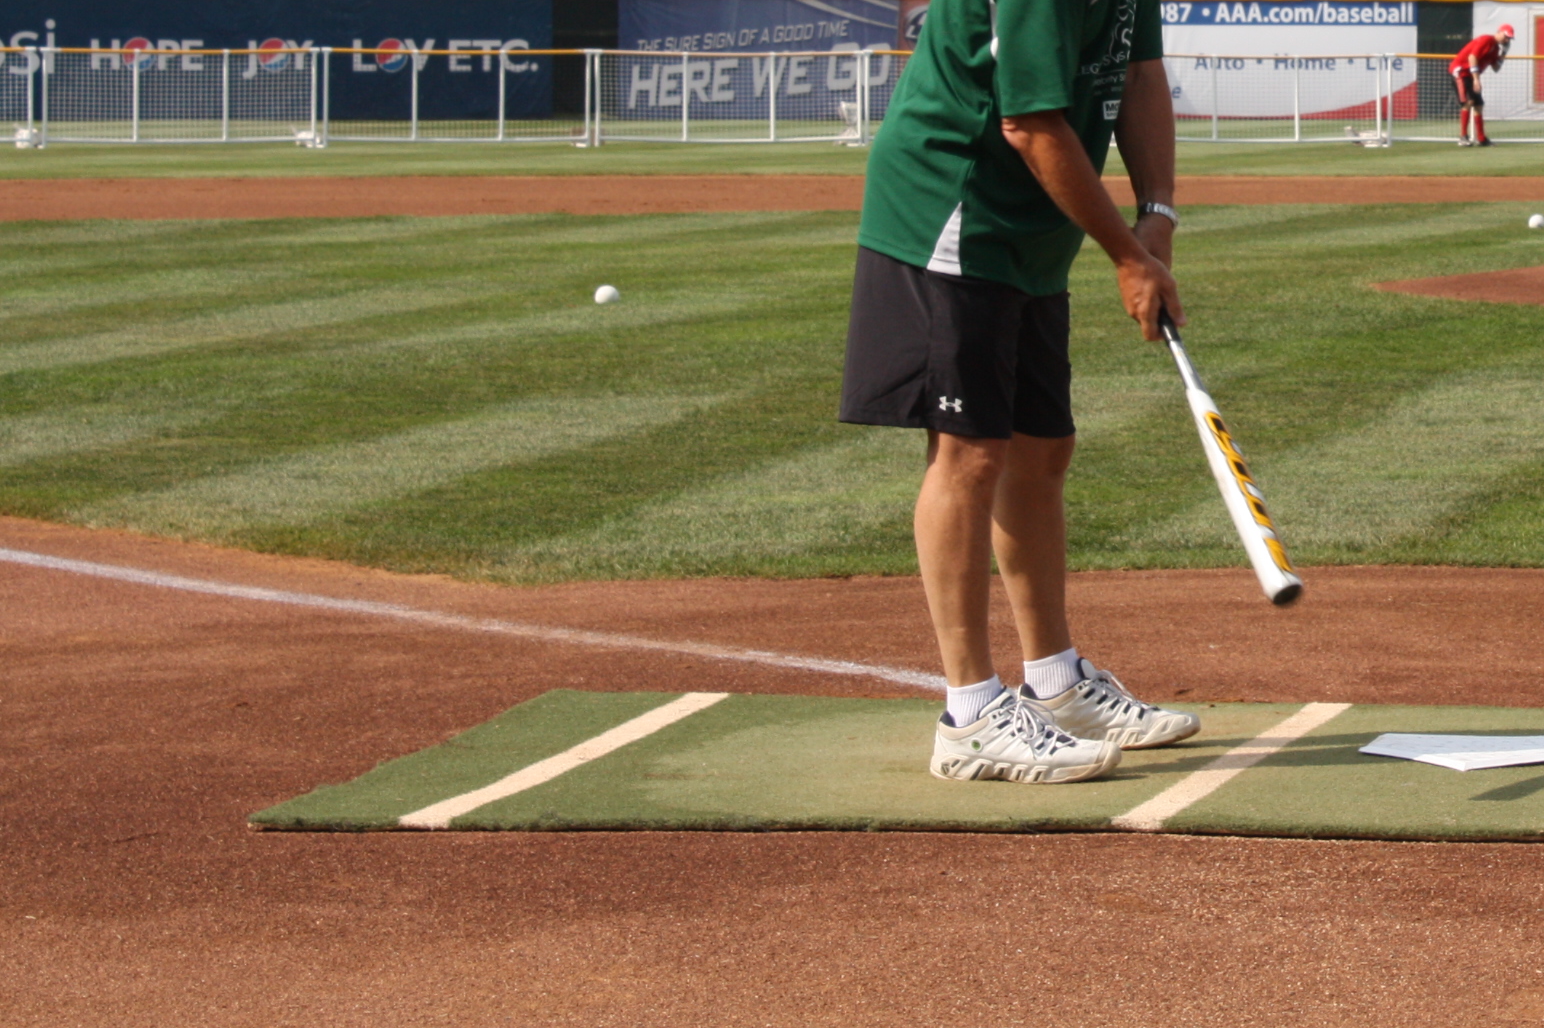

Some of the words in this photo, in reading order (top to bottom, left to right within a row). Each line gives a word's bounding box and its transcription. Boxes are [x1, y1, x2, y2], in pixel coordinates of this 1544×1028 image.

[1161, 2, 1193, 23] 87
[1215, 2, 1414, 24] AAA.com/baseball
[0, 18, 56, 75] si
[637, 39, 662, 52] THE
[664, 35, 701, 52] SURE
[703, 32, 735, 50] SIGN
[738, 28, 759, 47] OF
[759, 27, 771, 44] A
[773, 23, 815, 43] GOOD
[817, 19, 850, 38] TIME
[448, 38, 538, 72] ETC.
[1194, 53, 1245, 70] Auto
[1274, 53, 1336, 71] Home
[629, 58, 739, 110] HERE
[752, 51, 814, 98] WE
[826, 42, 892, 91] GO
